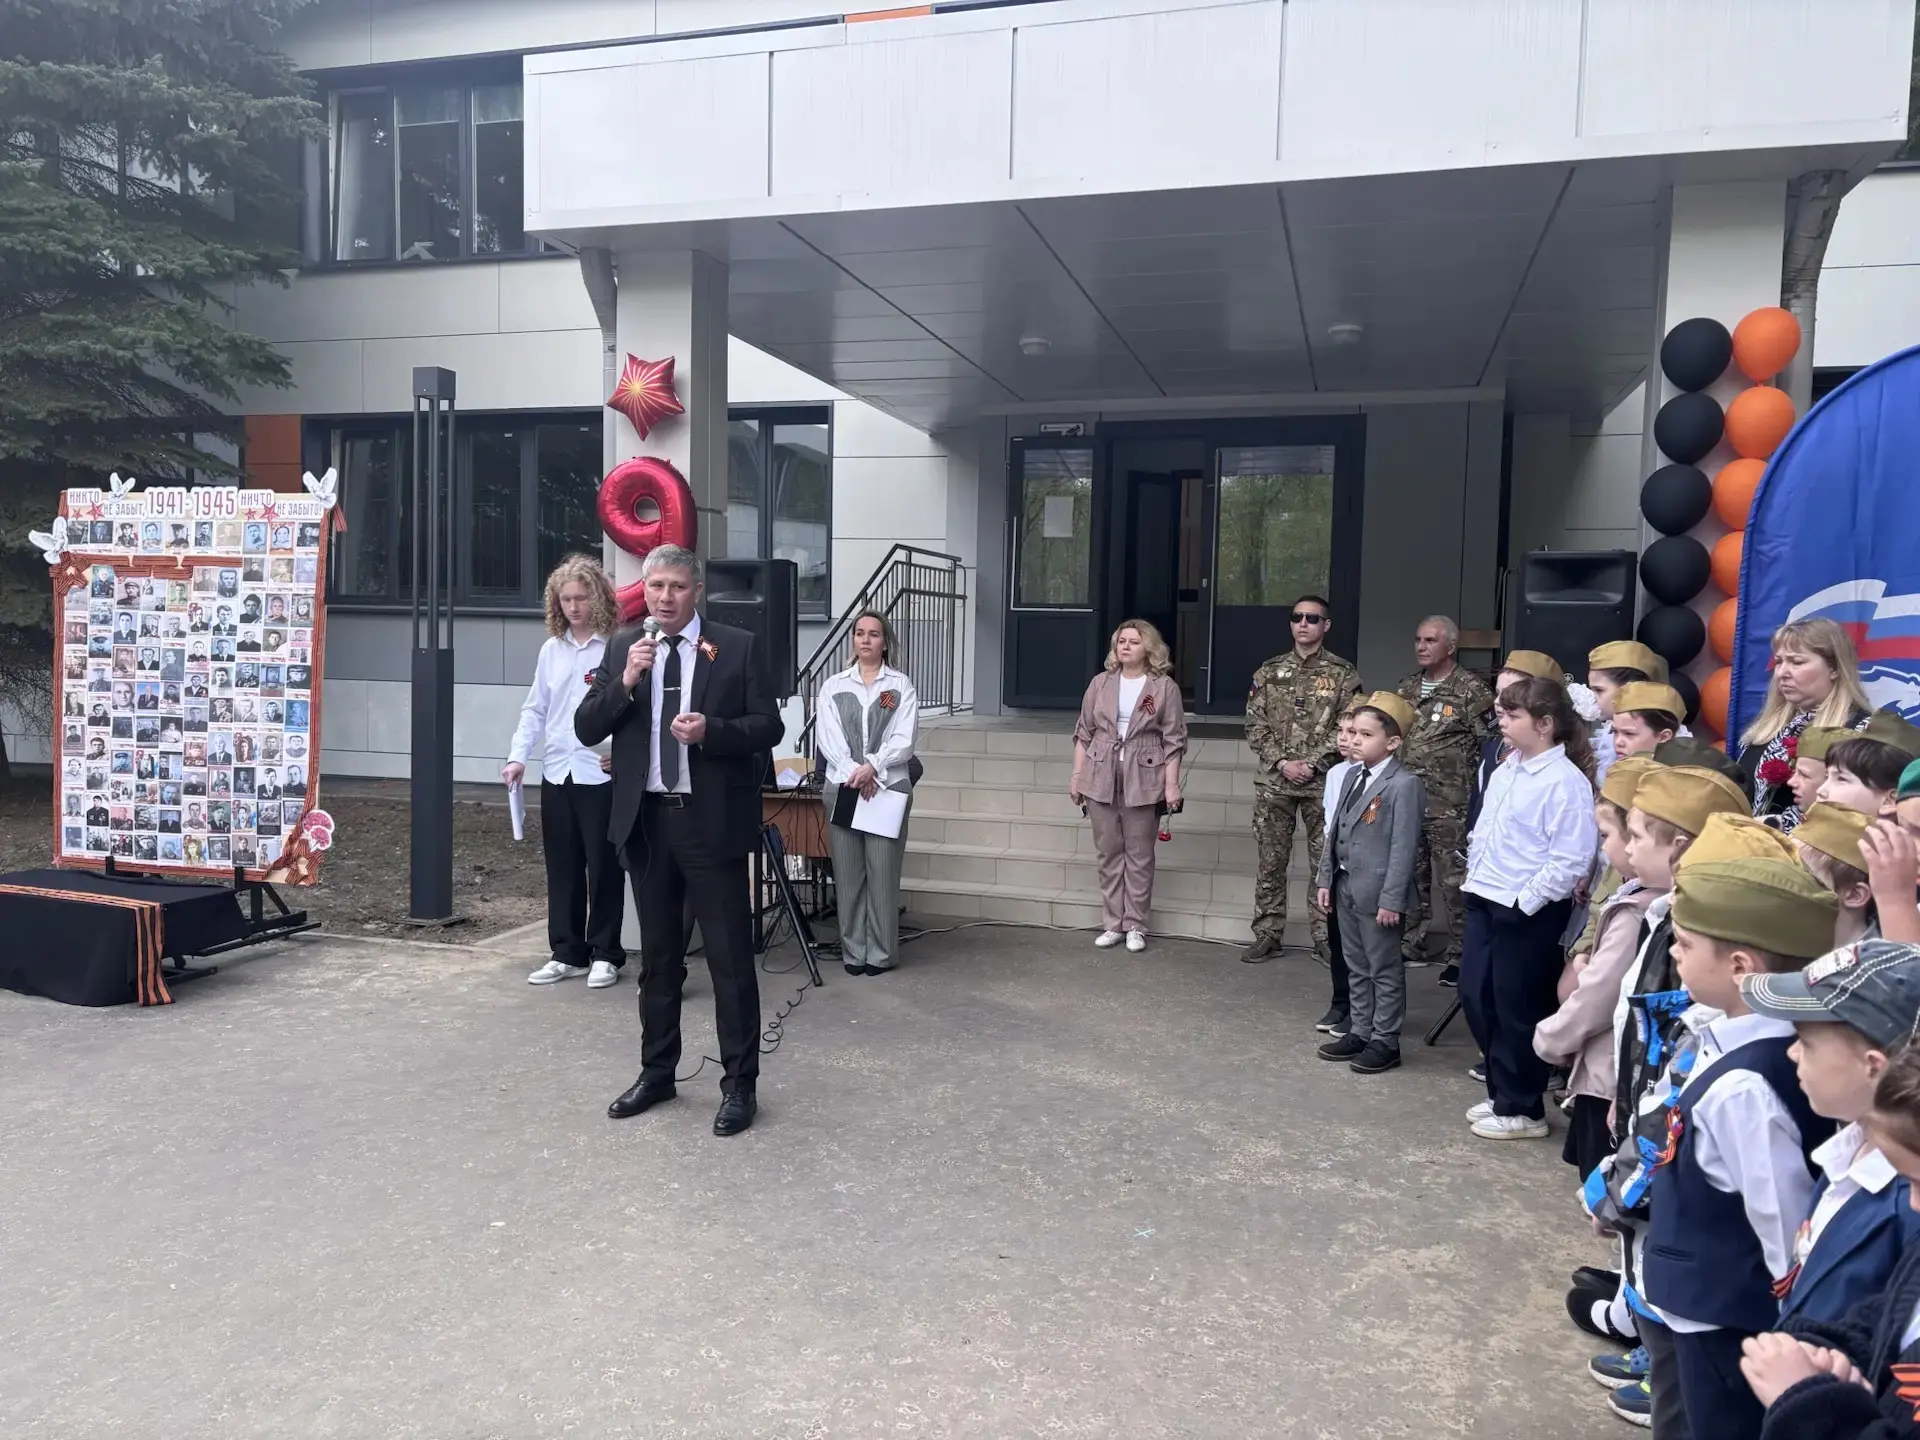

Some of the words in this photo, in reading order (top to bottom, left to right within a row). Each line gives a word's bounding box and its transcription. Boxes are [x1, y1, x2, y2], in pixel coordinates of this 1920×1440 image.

[69, 490, 100, 503] НИКТО
[241, 493, 272, 506] НИЧТО
[103, 502, 113, 516] НЕ
[277, 503, 287, 516] НЕ
[597, 456, 698, 623] 9
